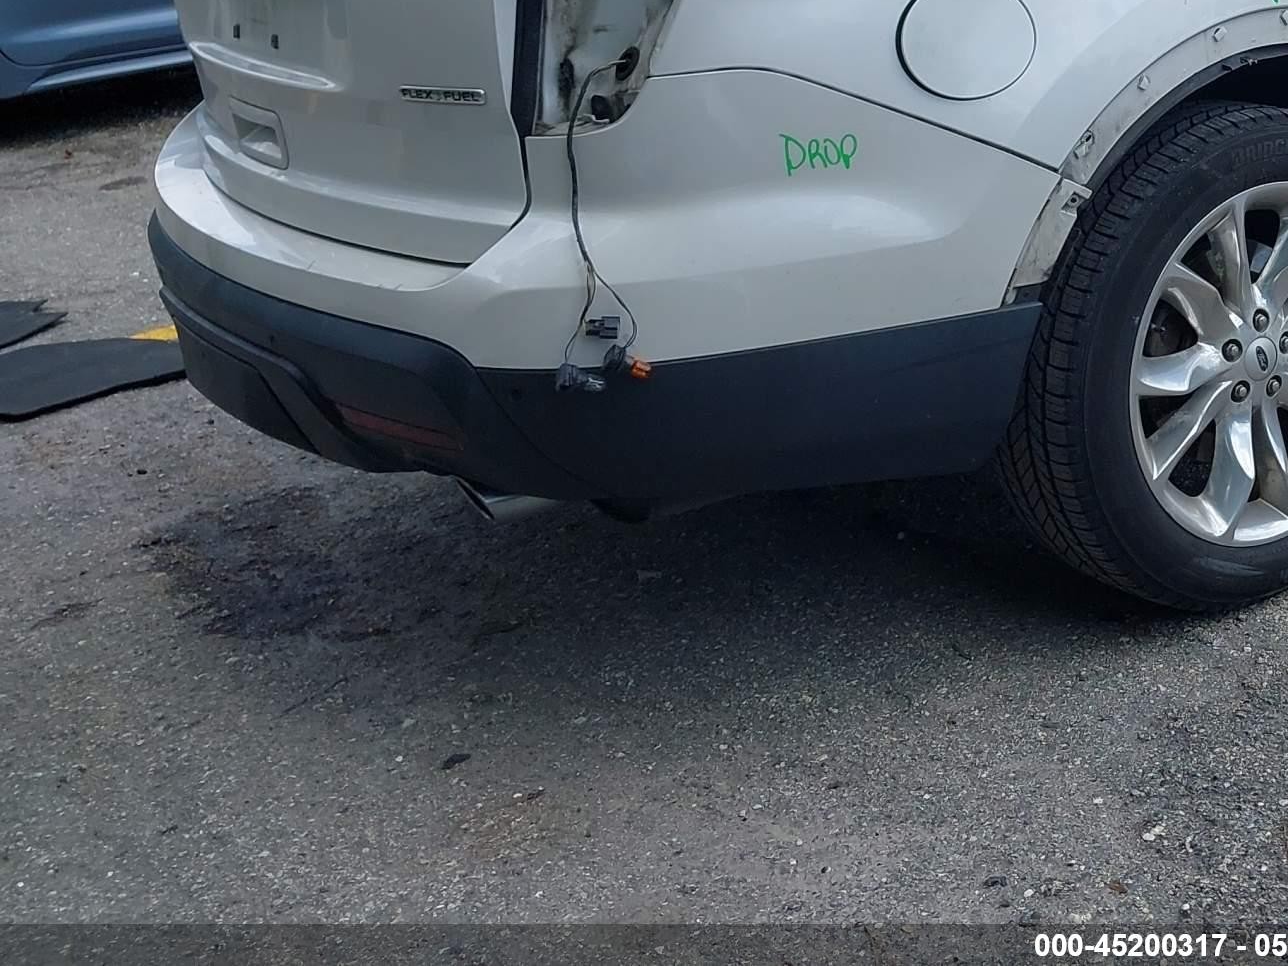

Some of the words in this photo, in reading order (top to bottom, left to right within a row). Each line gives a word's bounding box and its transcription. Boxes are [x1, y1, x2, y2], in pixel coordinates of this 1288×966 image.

[400, 89, 433, 99] FLEX
[443, 91, 482, 102] FUEL
[779, 133, 857, 176] DROP
